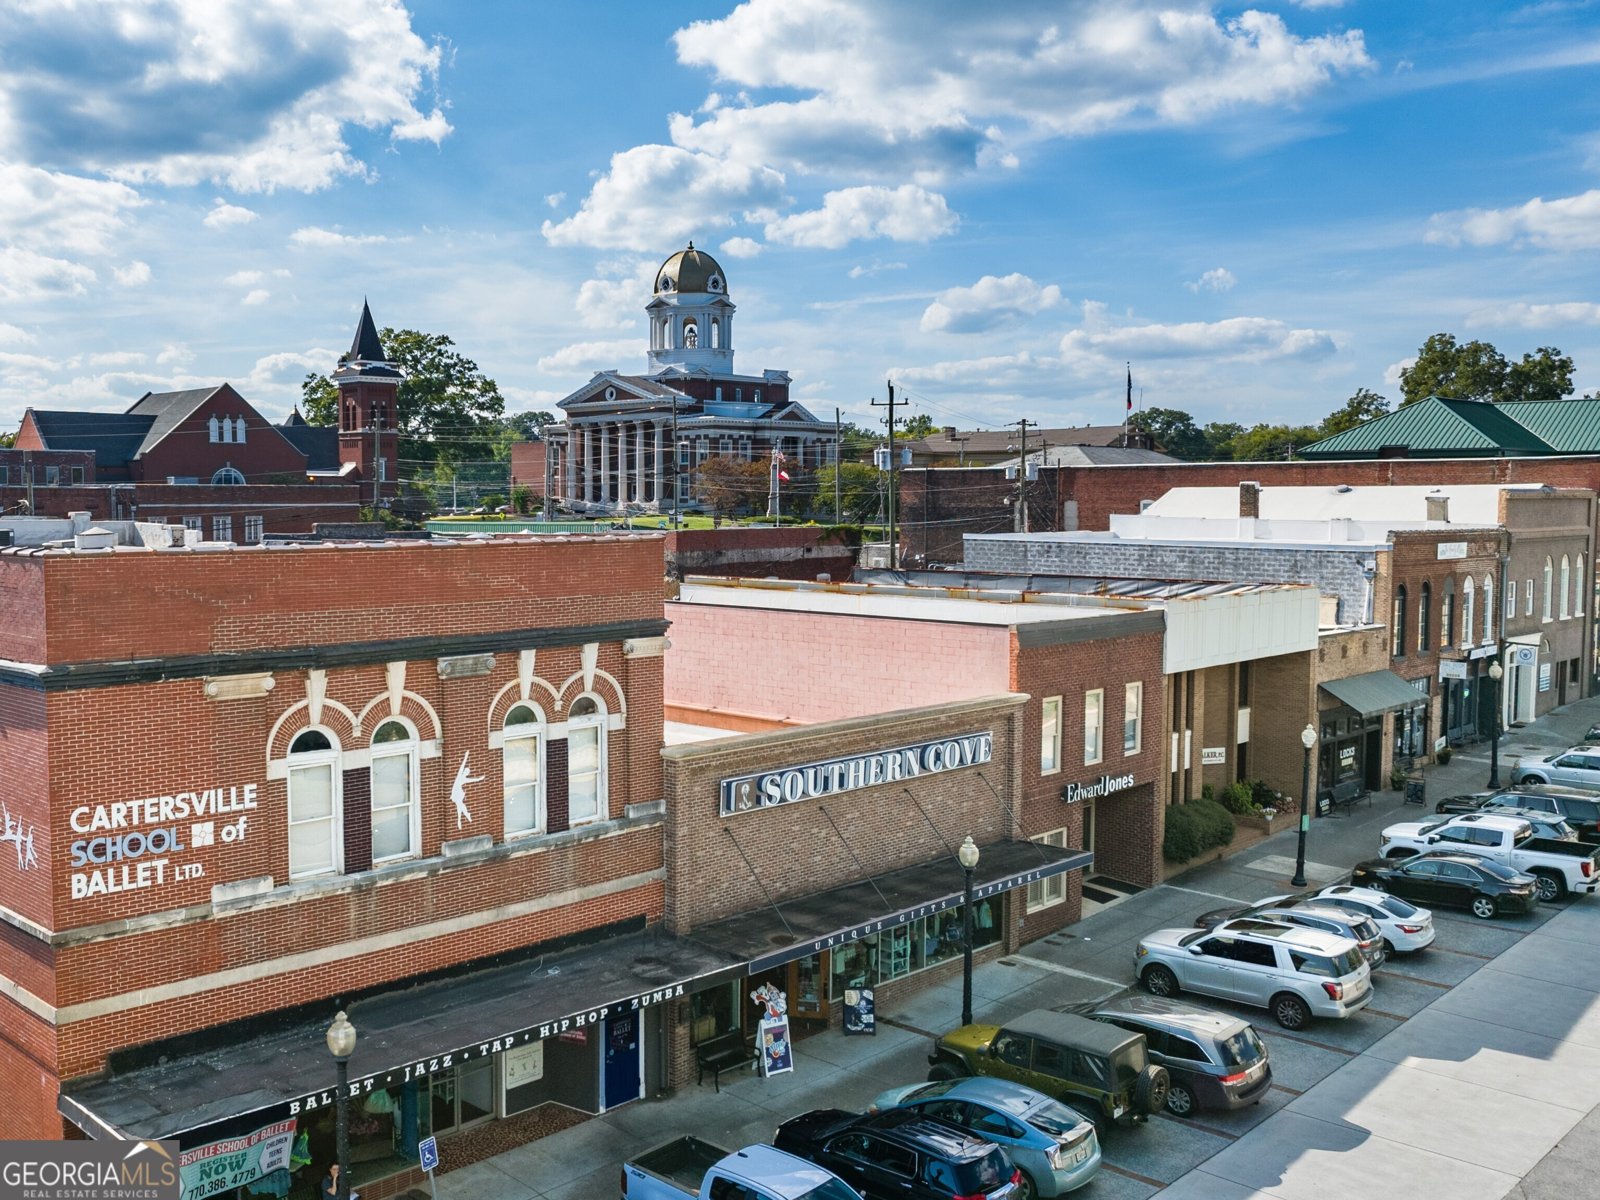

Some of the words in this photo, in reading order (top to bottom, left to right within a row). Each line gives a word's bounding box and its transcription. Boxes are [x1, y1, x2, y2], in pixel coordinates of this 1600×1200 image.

[761, 748, 921, 806] SOUTHERN
[924, 734, 993, 773] COVE
[70, 783, 258, 833] CARTERSVILLE
[70, 827, 185, 867] SCHOOL
[220, 816, 247, 842] of
[71, 858, 169, 899] BALLET
[174, 863, 206, 882] LTD.
[815, 922, 883, 950] UNIQUE
[899, 901, 947, 922] GIFTS
[978, 871, 1041, 897] APPAREL
[289, 1078, 375, 1116] BALET
[404, 1055, 452, 1082] JAZZ
[480, 1036, 514, 1056] TAP
[539, 1019, 570, 1038] HIP
[576, 1007, 609, 1028] HOP
[631, 984, 684, 1010] ZUMBA
[216, 1137, 249, 1154] SCHOOL
[251, 1131, 261, 1145] OF
[260, 1121, 290, 1140] BALLET
[266, 1136, 288, 1150] CHILDREN
[268, 1147, 283, 1158] TEENS
[199, 1152, 247, 1169] REGISTER
[199, 1158, 247, 1182] NOW
[231, 1167, 256, 1185] 4779
[266, 1157, 283, 1169] ADULTS
